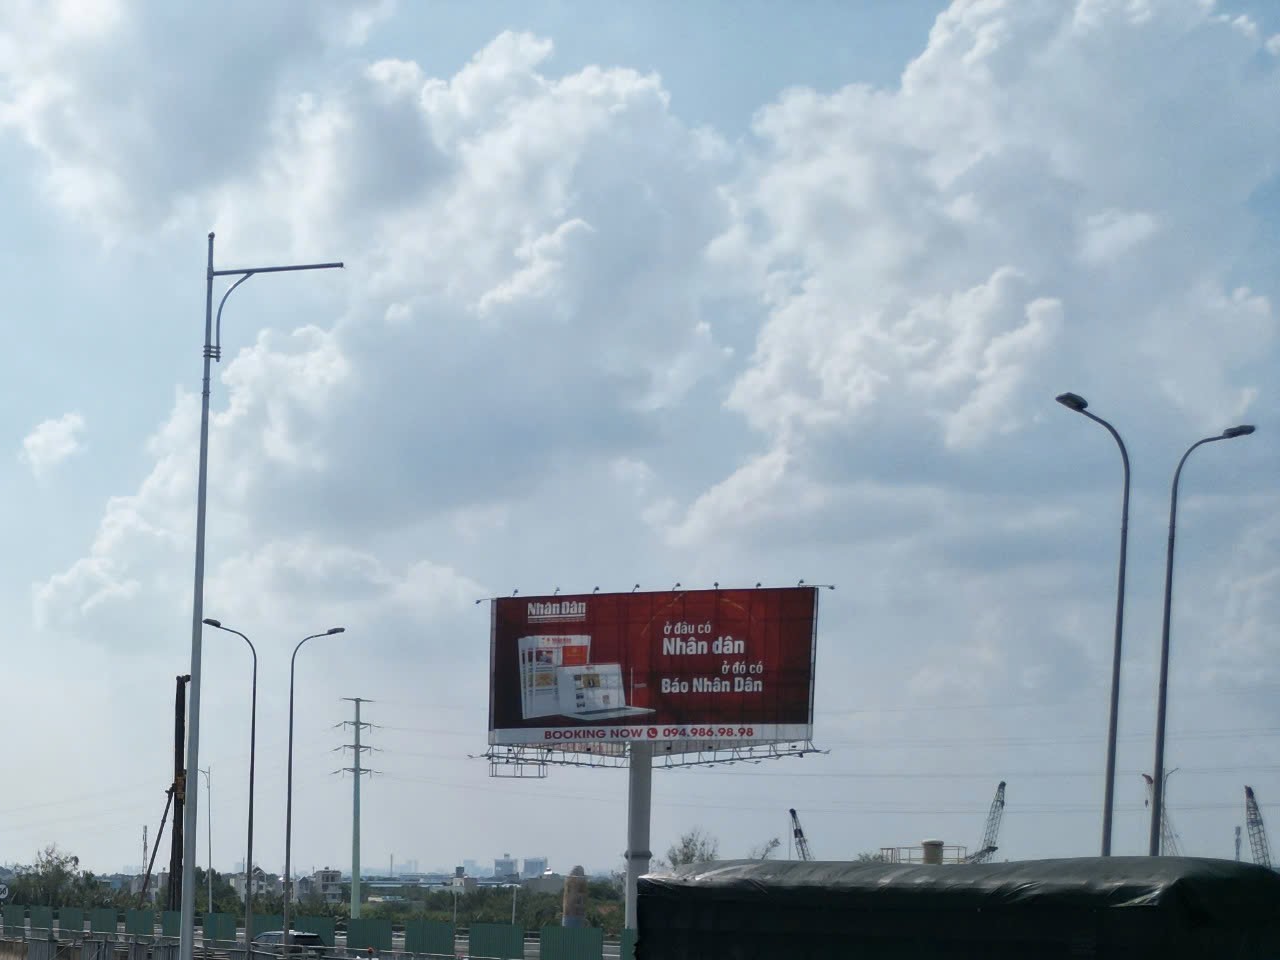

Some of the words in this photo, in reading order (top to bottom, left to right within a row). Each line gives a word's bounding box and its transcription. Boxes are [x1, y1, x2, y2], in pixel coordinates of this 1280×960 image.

[527, 601, 560, 616] Nhân
[561, 600, 586, 615] Dân
[663, 620, 673, 635] ở
[674, 621, 695, 635] đâu
[697, 620, 712, 634] có
[662, 636, 708, 655] Nhân
[712, 635, 745, 654] dân
[721, 660, 730, 674] ở
[732, 661, 746, 674] đó
[749, 660, 764, 674] có
[661, 678, 689, 693] Báo
[692, 676, 730, 693] Nhân
[734, 676, 763, 692] Dân
[544, 729, 606, 740] BOOKING
[610, 728, 643, 739] NOW
[662, 727, 754, 739] 094.986.98.98
